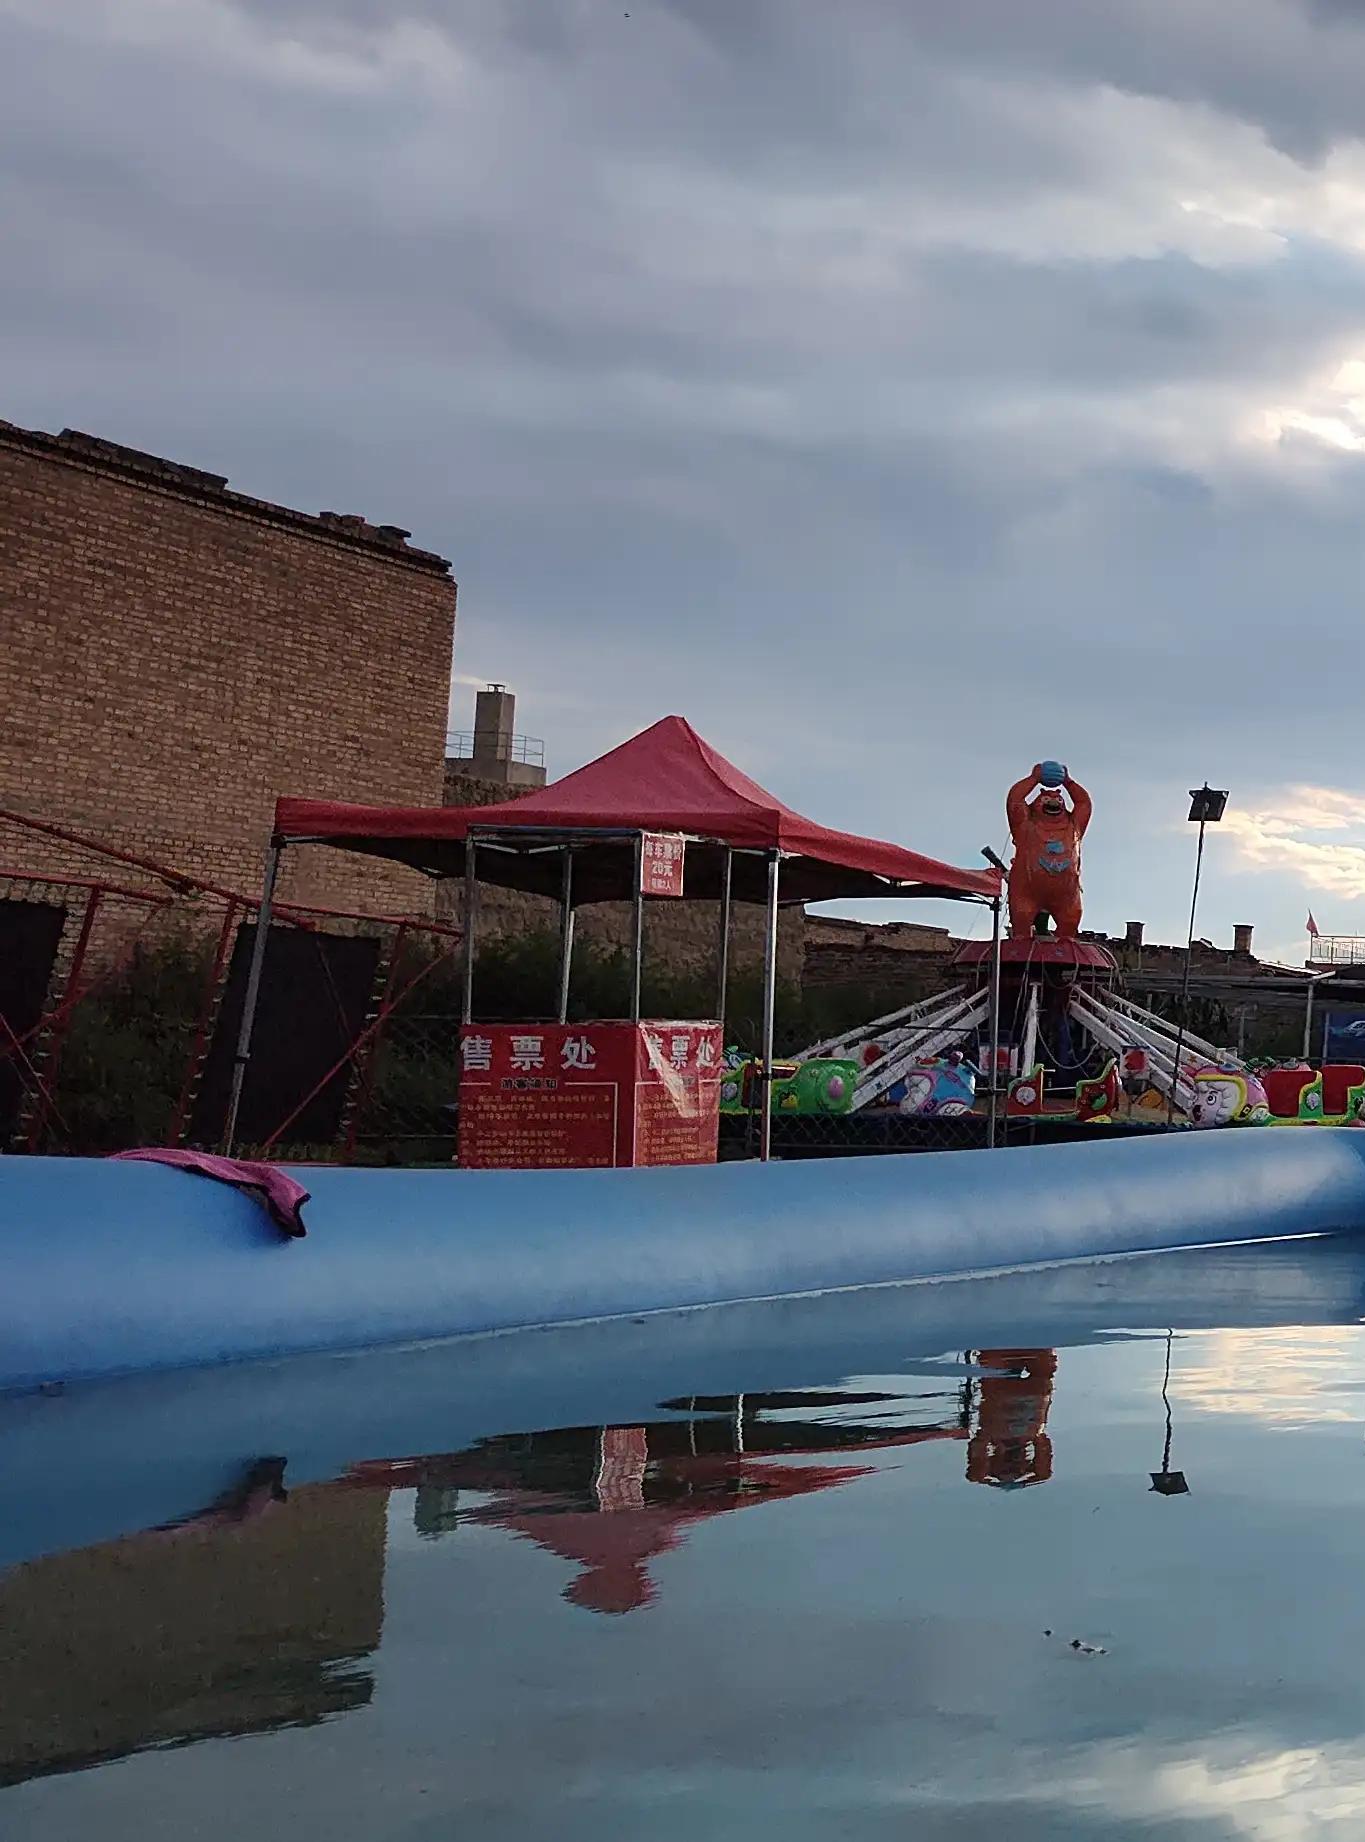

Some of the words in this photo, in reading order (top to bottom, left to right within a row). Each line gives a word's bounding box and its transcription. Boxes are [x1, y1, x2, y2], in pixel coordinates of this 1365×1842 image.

[652, 860, 673, 877] 20元
[460, 1034, 596, 1072] 售票处
